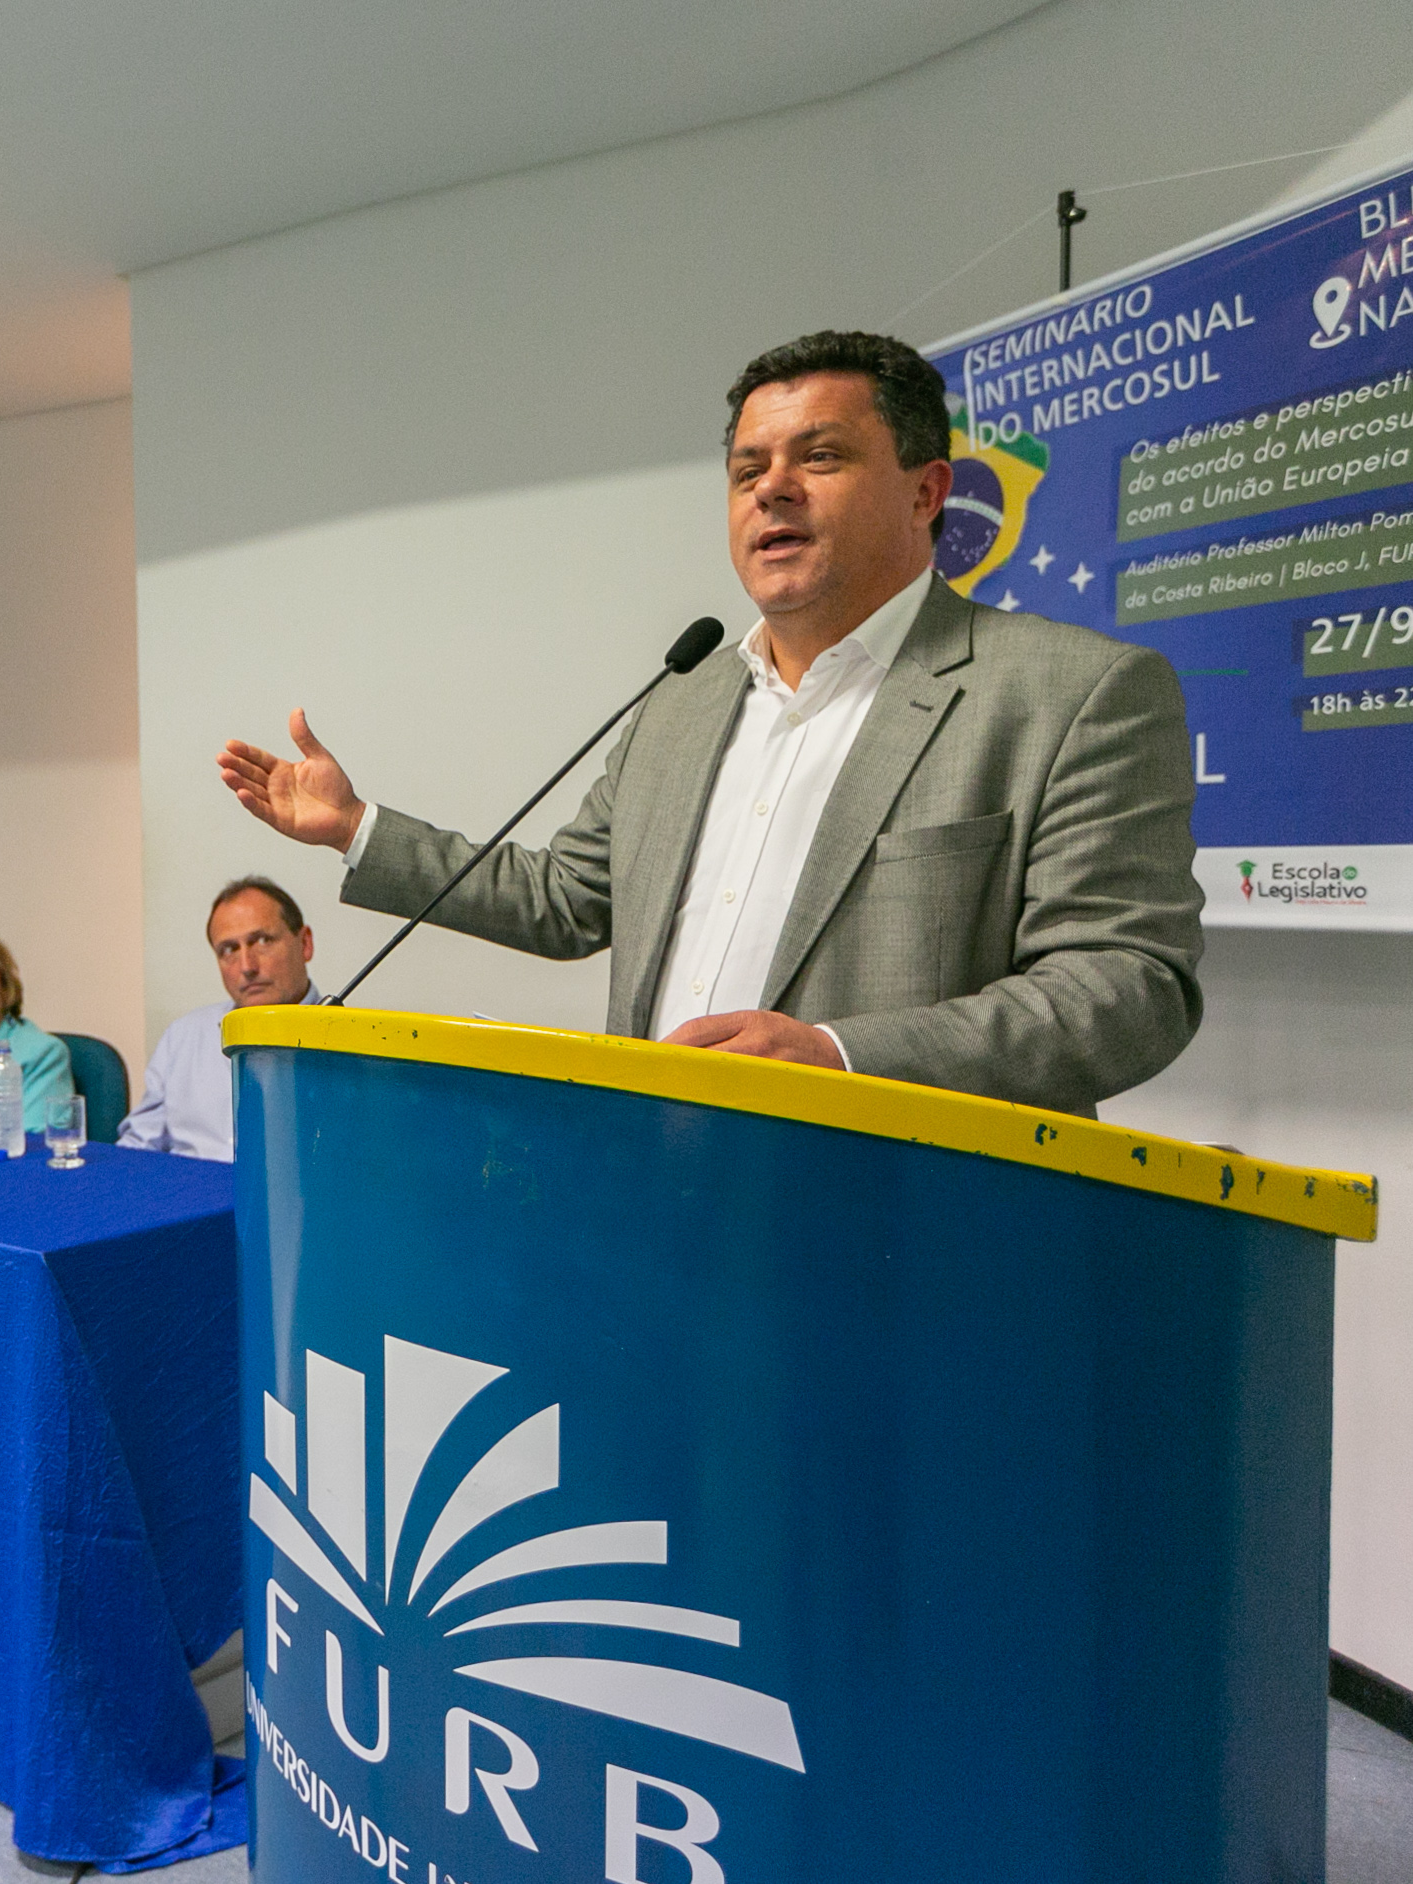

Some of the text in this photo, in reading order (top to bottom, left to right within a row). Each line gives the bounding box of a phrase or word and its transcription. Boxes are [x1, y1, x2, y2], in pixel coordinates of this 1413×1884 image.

[1359, 186, 1413, 239] BL
[976, 293, 1255, 413] INTERNACIONAL
[977, 351, 1221, 451] DO MERCOSUL
[1130, 369, 1413, 464] Os efeitos e perspecti
[1125, 447, 1409, 526] com a União Europeia
[1127, 469, 1155, 495] do
[1162, 447, 1244, 486] acordo
[1253, 437, 1286, 464] do
[1125, 549, 1202, 578] Auditório
[1207, 533, 1295, 562] Professor
[1299, 515, 1363, 545] Milton
[1125, 590, 1147, 609] da
[1152, 582, 1203, 603] Costa
[1208, 572, 1273, 595] Ribeiro
[1292, 558, 1349, 581] Bloco
[1310, 606, 1413, 659] 27/9
[1310, 692, 1351, 715] 18h
[1360, 690, 1385, 712] às
[1257, 881, 1367, 903] Legislativo
[1272, 862, 1340, 880] Escola
[266, 1577, 726, 1884] FURB
[246, 1670, 410, 1884] UNIVERSIDADE
